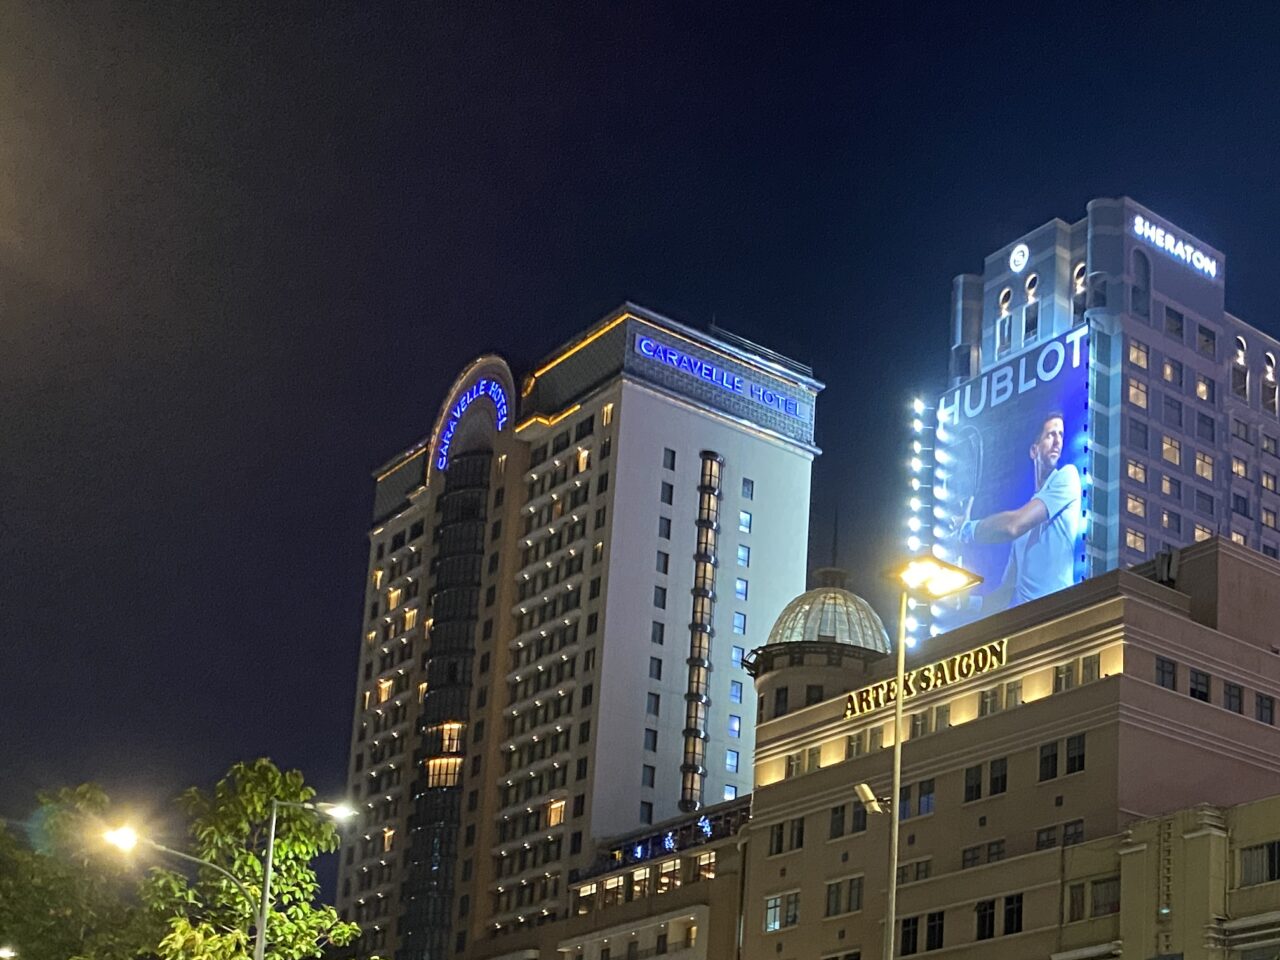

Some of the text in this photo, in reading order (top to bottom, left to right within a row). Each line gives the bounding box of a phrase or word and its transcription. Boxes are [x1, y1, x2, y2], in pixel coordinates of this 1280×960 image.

[1133, 215, 1217, 278] SHERATON
[640, 337, 806, 418] CARAVELLE HOTEL
[939, 327, 1088, 427] HUBLOT
[437, 379, 507, 470] CARAVELLE HOTEL
[919, 639, 1008, 692] SAIGON
